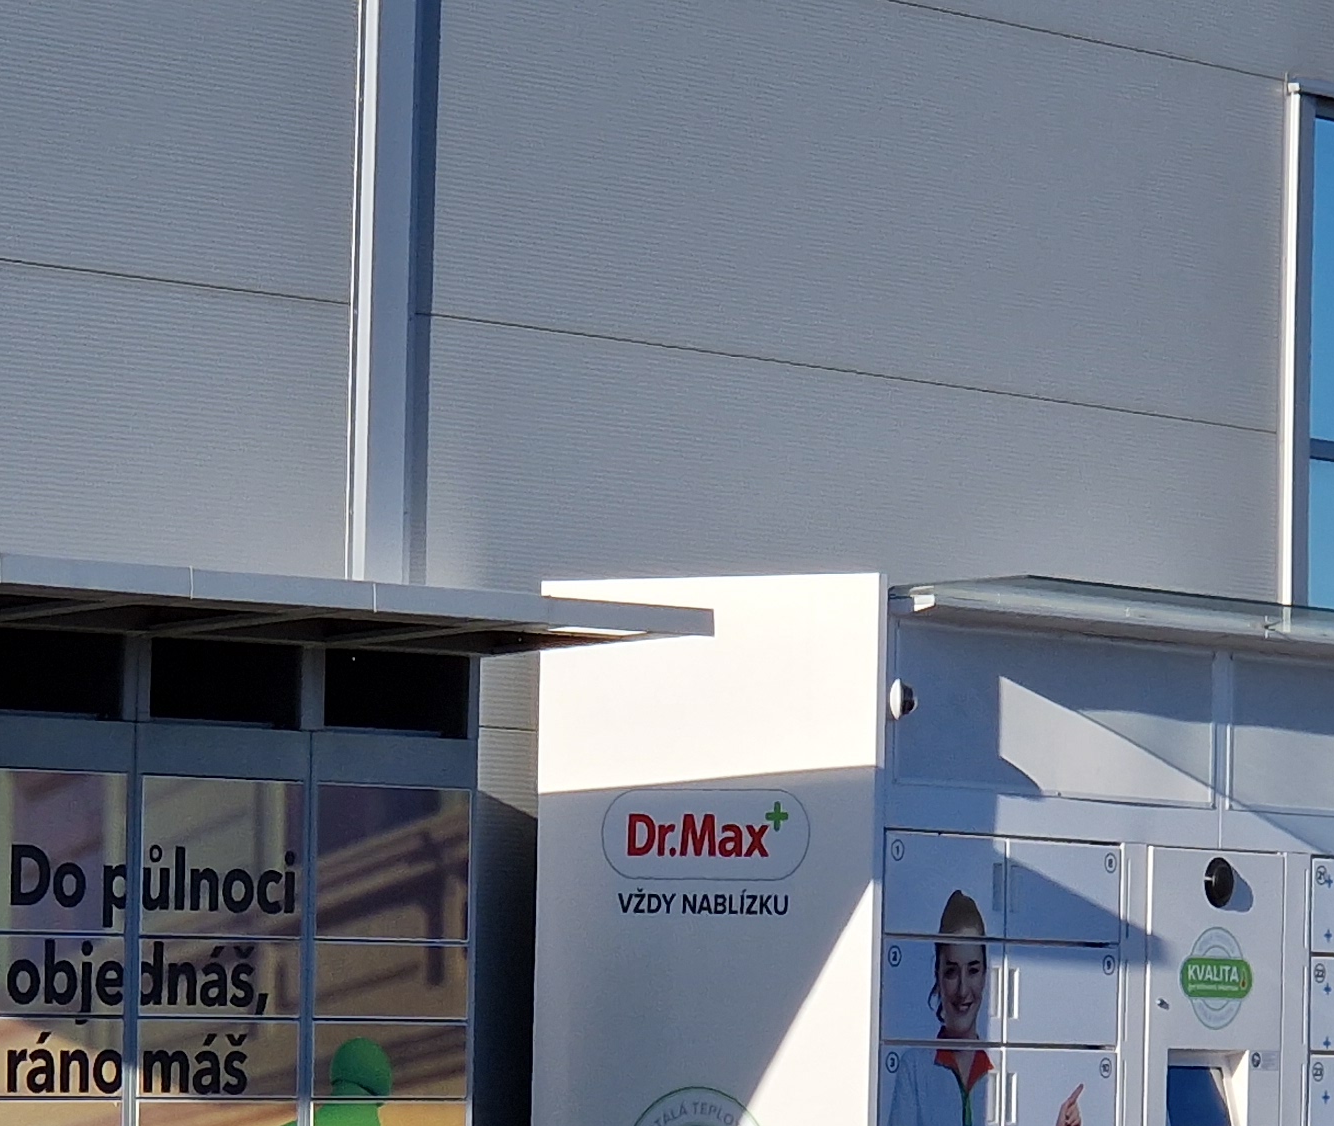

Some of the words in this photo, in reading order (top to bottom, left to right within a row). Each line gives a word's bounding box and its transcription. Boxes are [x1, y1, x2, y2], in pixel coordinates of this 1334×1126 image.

[10, 843, 87, 909] Do
[102, 844, 296, 928] půlnoci
[617, 886, 677, 915] VŽDY
[681, 888, 789, 916] NABLÍZKU
[6, 938, 269, 1025] objednáš,
[1187, 963, 1240, 983] KVALITA
[6, 1031, 123, 1094] ráno
[142, 1033, 248, 1095] máš
